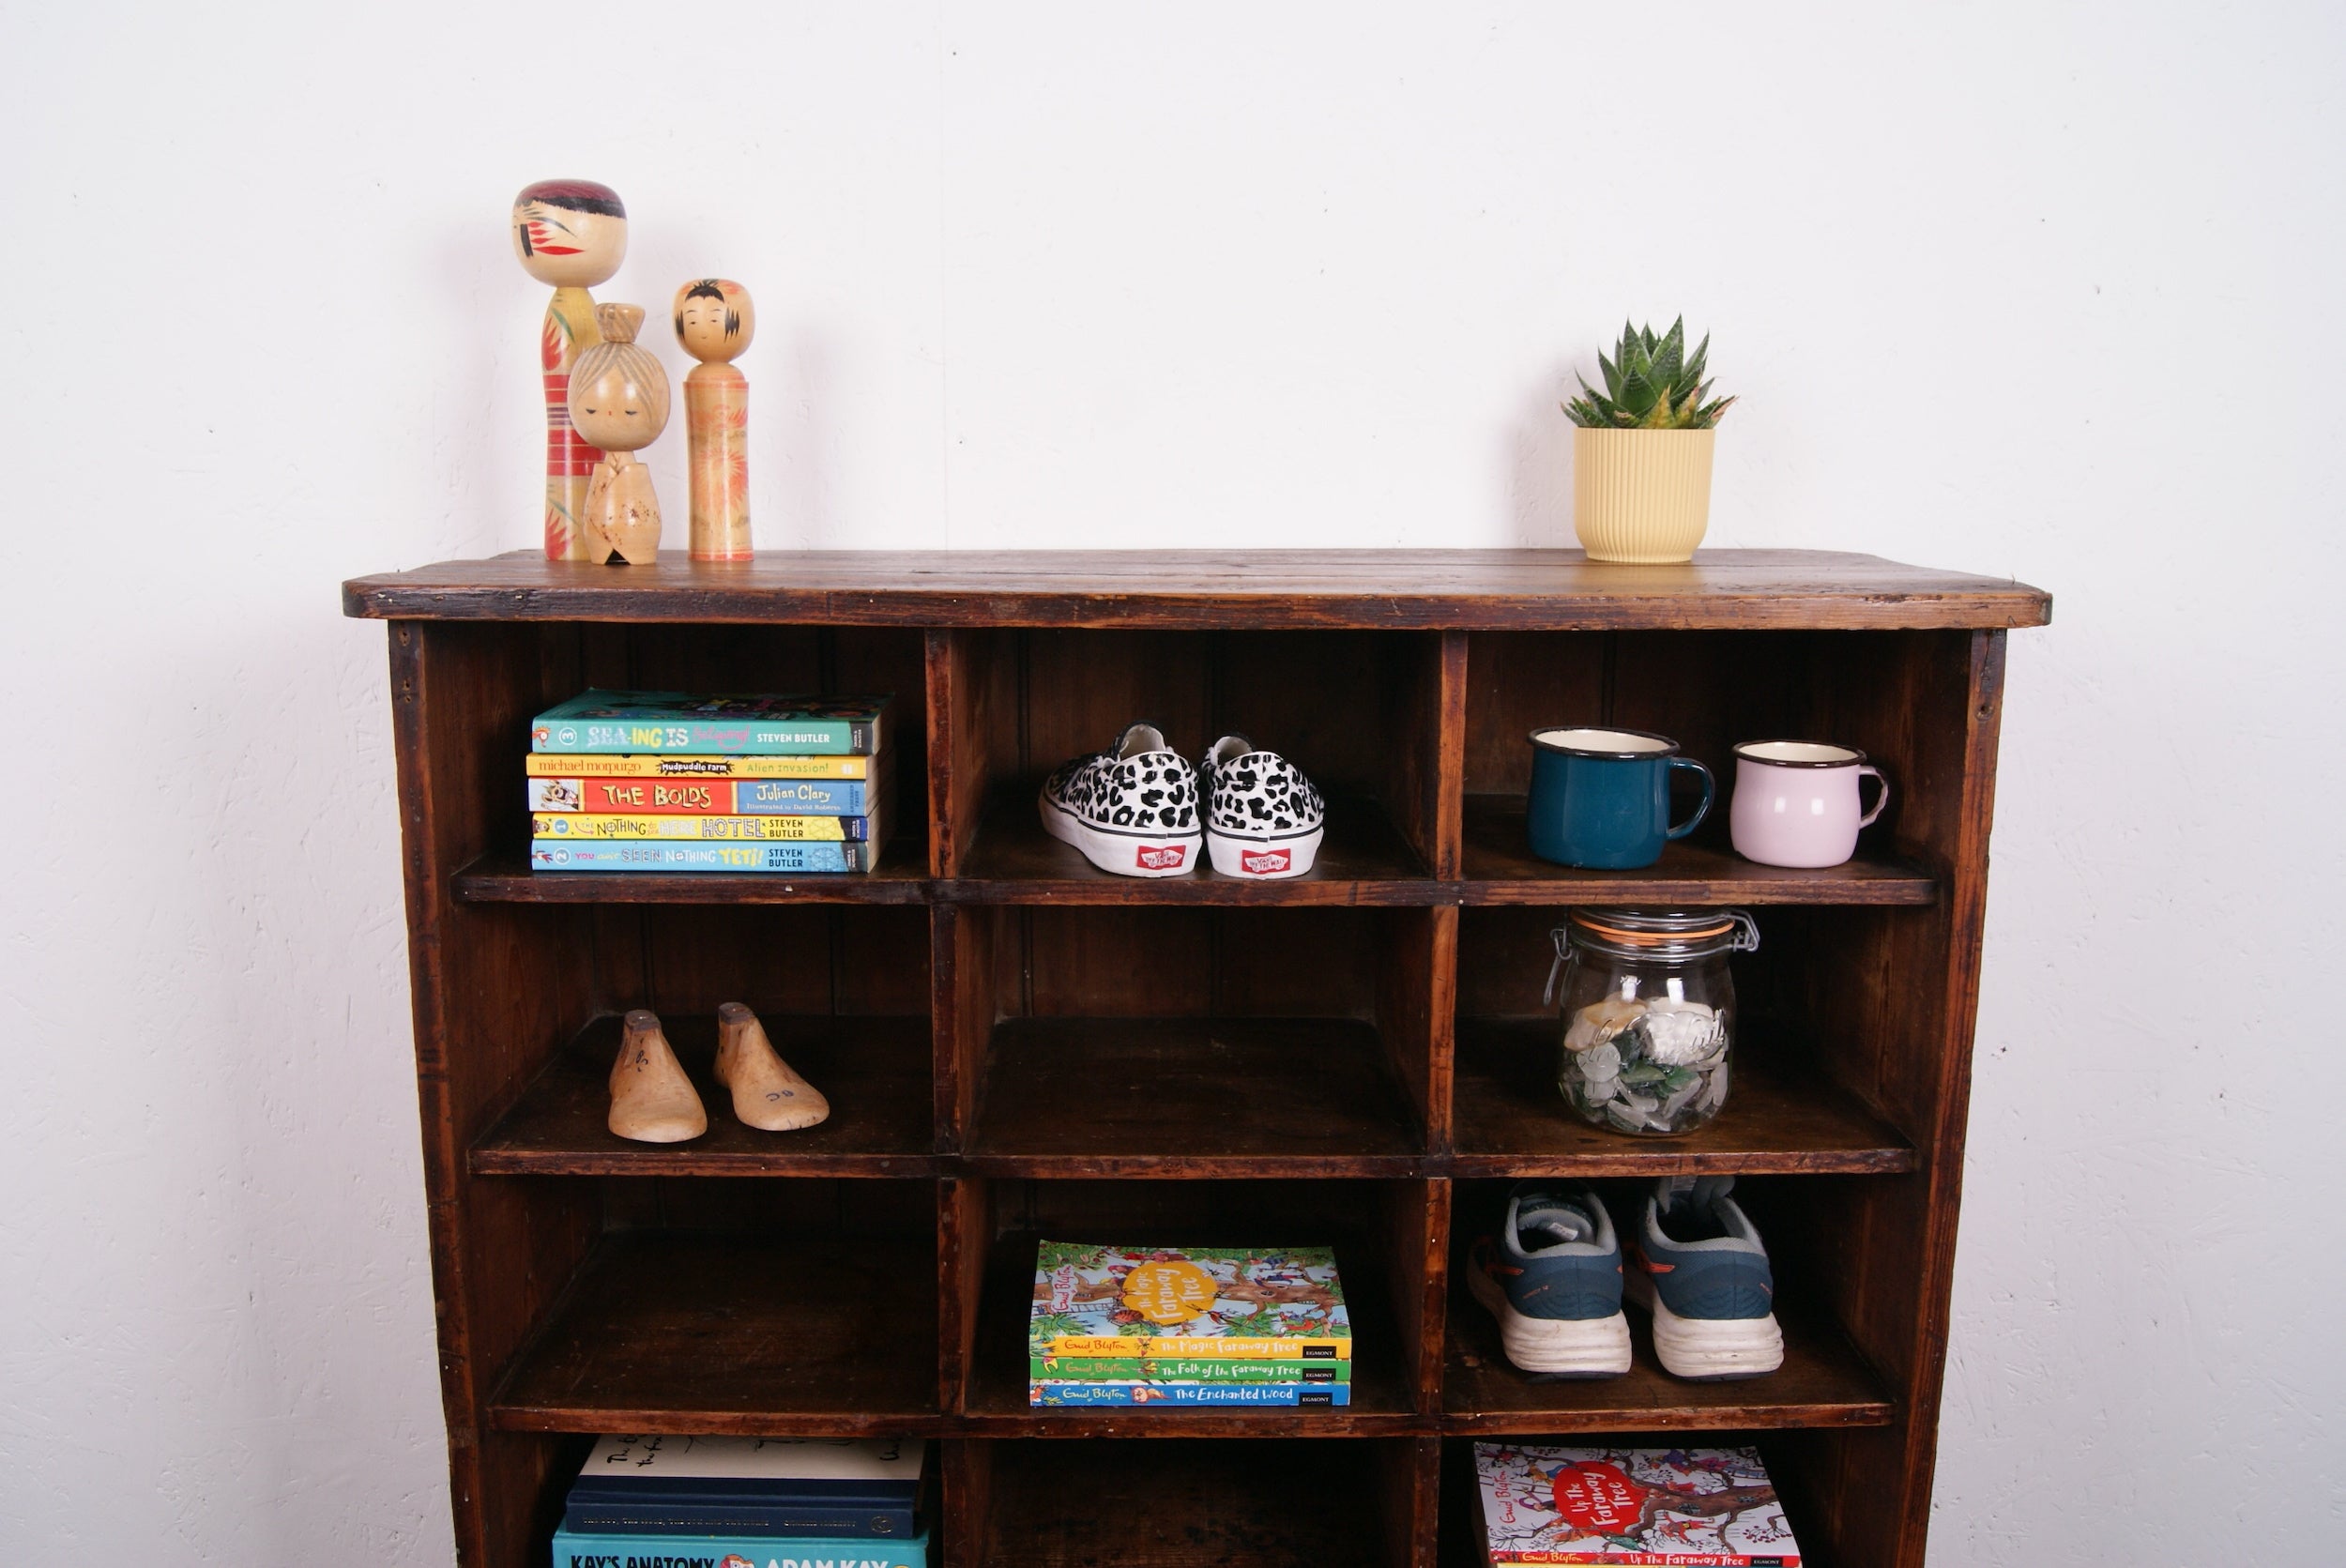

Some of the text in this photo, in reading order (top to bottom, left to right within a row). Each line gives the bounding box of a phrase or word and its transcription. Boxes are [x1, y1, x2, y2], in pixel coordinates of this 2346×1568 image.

[665, 727, 689, 747] IS
[756, 734, 830, 743] STEVEN BUTLER
[539, 759, 642, 775] michael morpurgo
[662, 763, 706, 771] Mudpuddle
[747, 763, 774, 772] Alien
[601, 784, 712, 809] THE BOLDS
[756, 783, 830, 802] Julian Clary
[597, 818, 647, 836] NOTHING
[660, 819, 697, 836] HERE
[701, 818, 766, 837] HOTEL
[769, 830, 804, 838] BUTLER
[621, 848, 662, 862] SEEN
[665, 849, 716, 863] NOTHING
[1054, 1265, 1074, 1289] Blyton
[1150, 1269, 1183, 1318] Faraway
[1177, 1277, 1206, 1302] Tree
[1064, 1339, 1127, 1351] Enid Blyton
[1179, 1340, 1214, 1354] Magic
[1217, 1341, 1270, 1354] Faraway
[1272, 1342, 1298, 1353] Tree
[1065, 1362, 1128, 1374] Enid Blyton
[1162, 1362, 1301, 1378] The Folk of the Faraway Tree
[1062, 1388, 1126, 1400] Enid Blyton
[1174, 1388, 1293, 1401] The Enchanted Wood
[1493, 1470, 1516, 1524] Enid Blyton
[1564, 1483, 1592, 1513] Up The
[1583, 1472, 1620, 1526] Faraway
[1607, 1482, 1635, 1510] Tree
[626, 1556, 715, 1568] ANATOMY
[1522, 1552, 1584, 1563] Enid Blyton
[1630, 1554, 1744, 1566] Up The Faraway Tree
